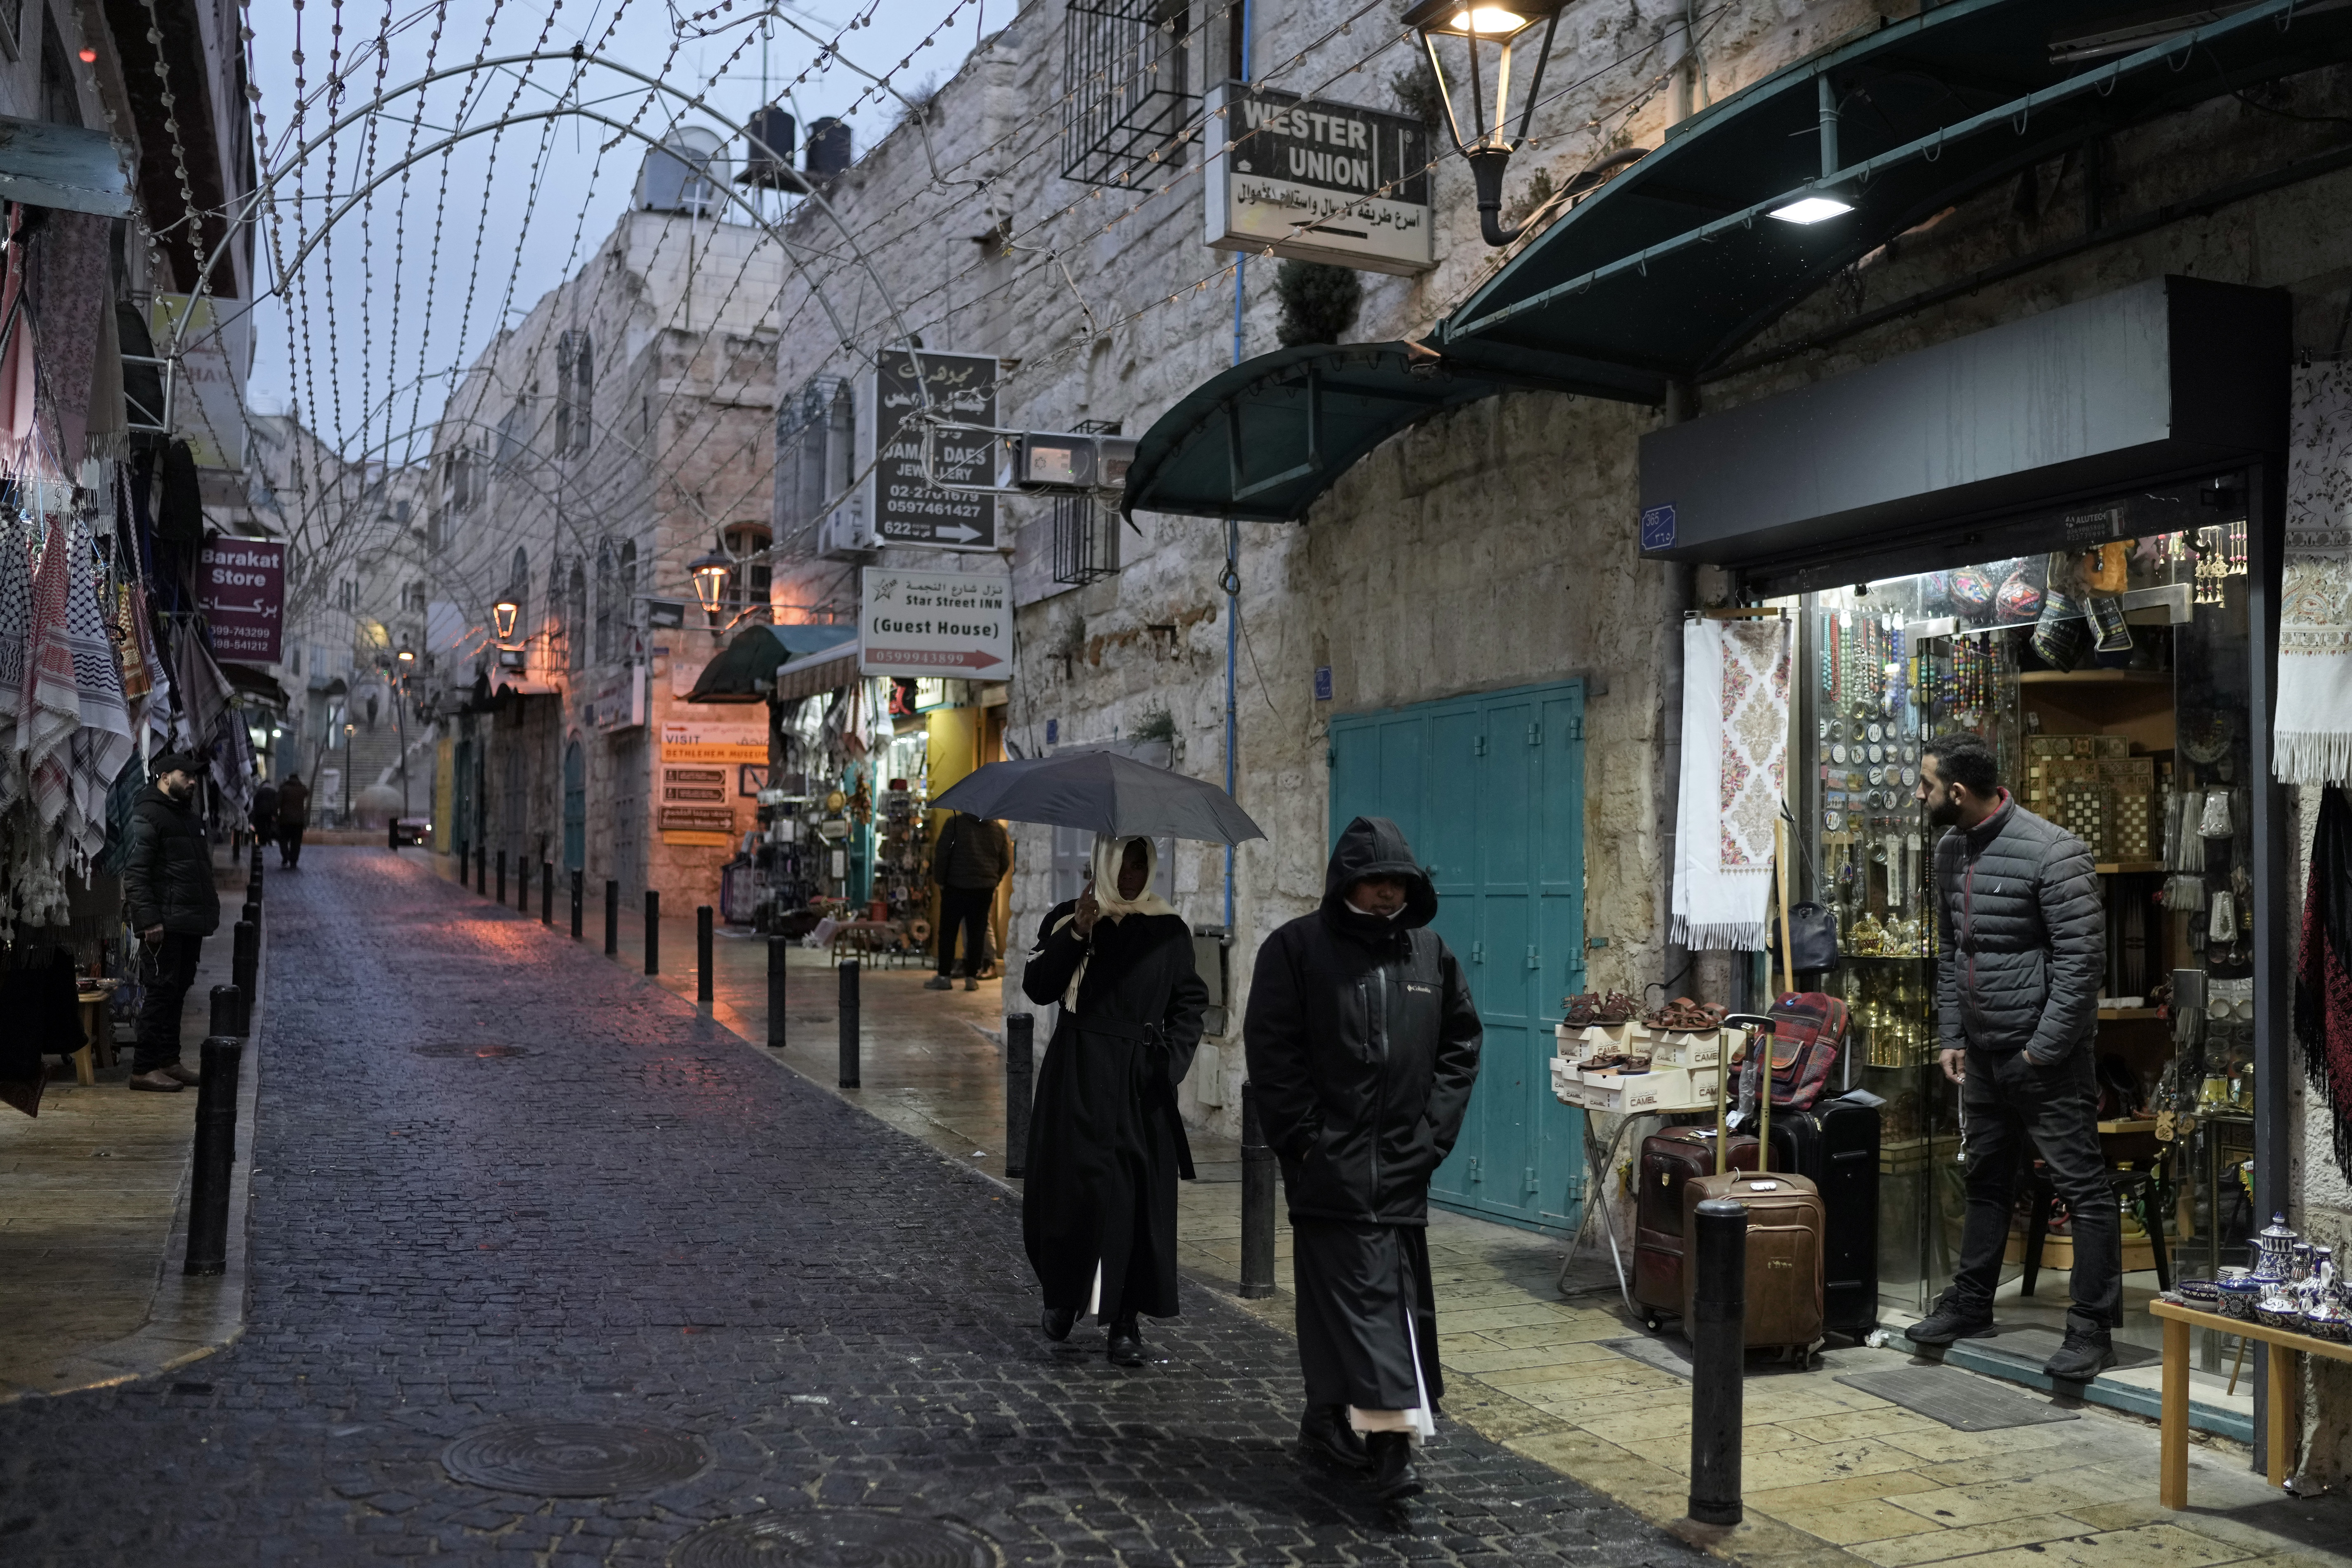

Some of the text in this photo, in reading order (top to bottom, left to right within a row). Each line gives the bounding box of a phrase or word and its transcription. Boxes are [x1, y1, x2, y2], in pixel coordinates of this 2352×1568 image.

[1243, 99, 1368, 150] WESTER
[1289, 146, 1370, 192] UNION
[884, 443, 987, 465] JAM DAES
[896, 463, 973, 481] JEWLERY
[887, 501, 981, 518] 0597461427
[1646, 512, 1659, 527] 365
[884, 521, 912, 536] 622
[201, 548, 279, 569] Barakat
[212, 568, 266, 587] Store
[881, 579, 899, 594] STAR
[906, 580, 1003, 597] نزل شارع النجمة
[198, 595, 277, 619] بركات
[906, 595, 1002, 609] Star Street INN
[874, 617, 999, 640] (Guest House)
[876, 650, 964, 664] 0599943899
[666, 734, 701, 746] VISIT
[666, 749, 725, 758] BETHLEHEM
[1412, 985, 1431, 994] Columbia
[1598, 1046, 1621, 1055] CAMEL
[1699, 1088, 1718, 1096] CAM
[1630, 1096, 1657, 1107] CAMEL
